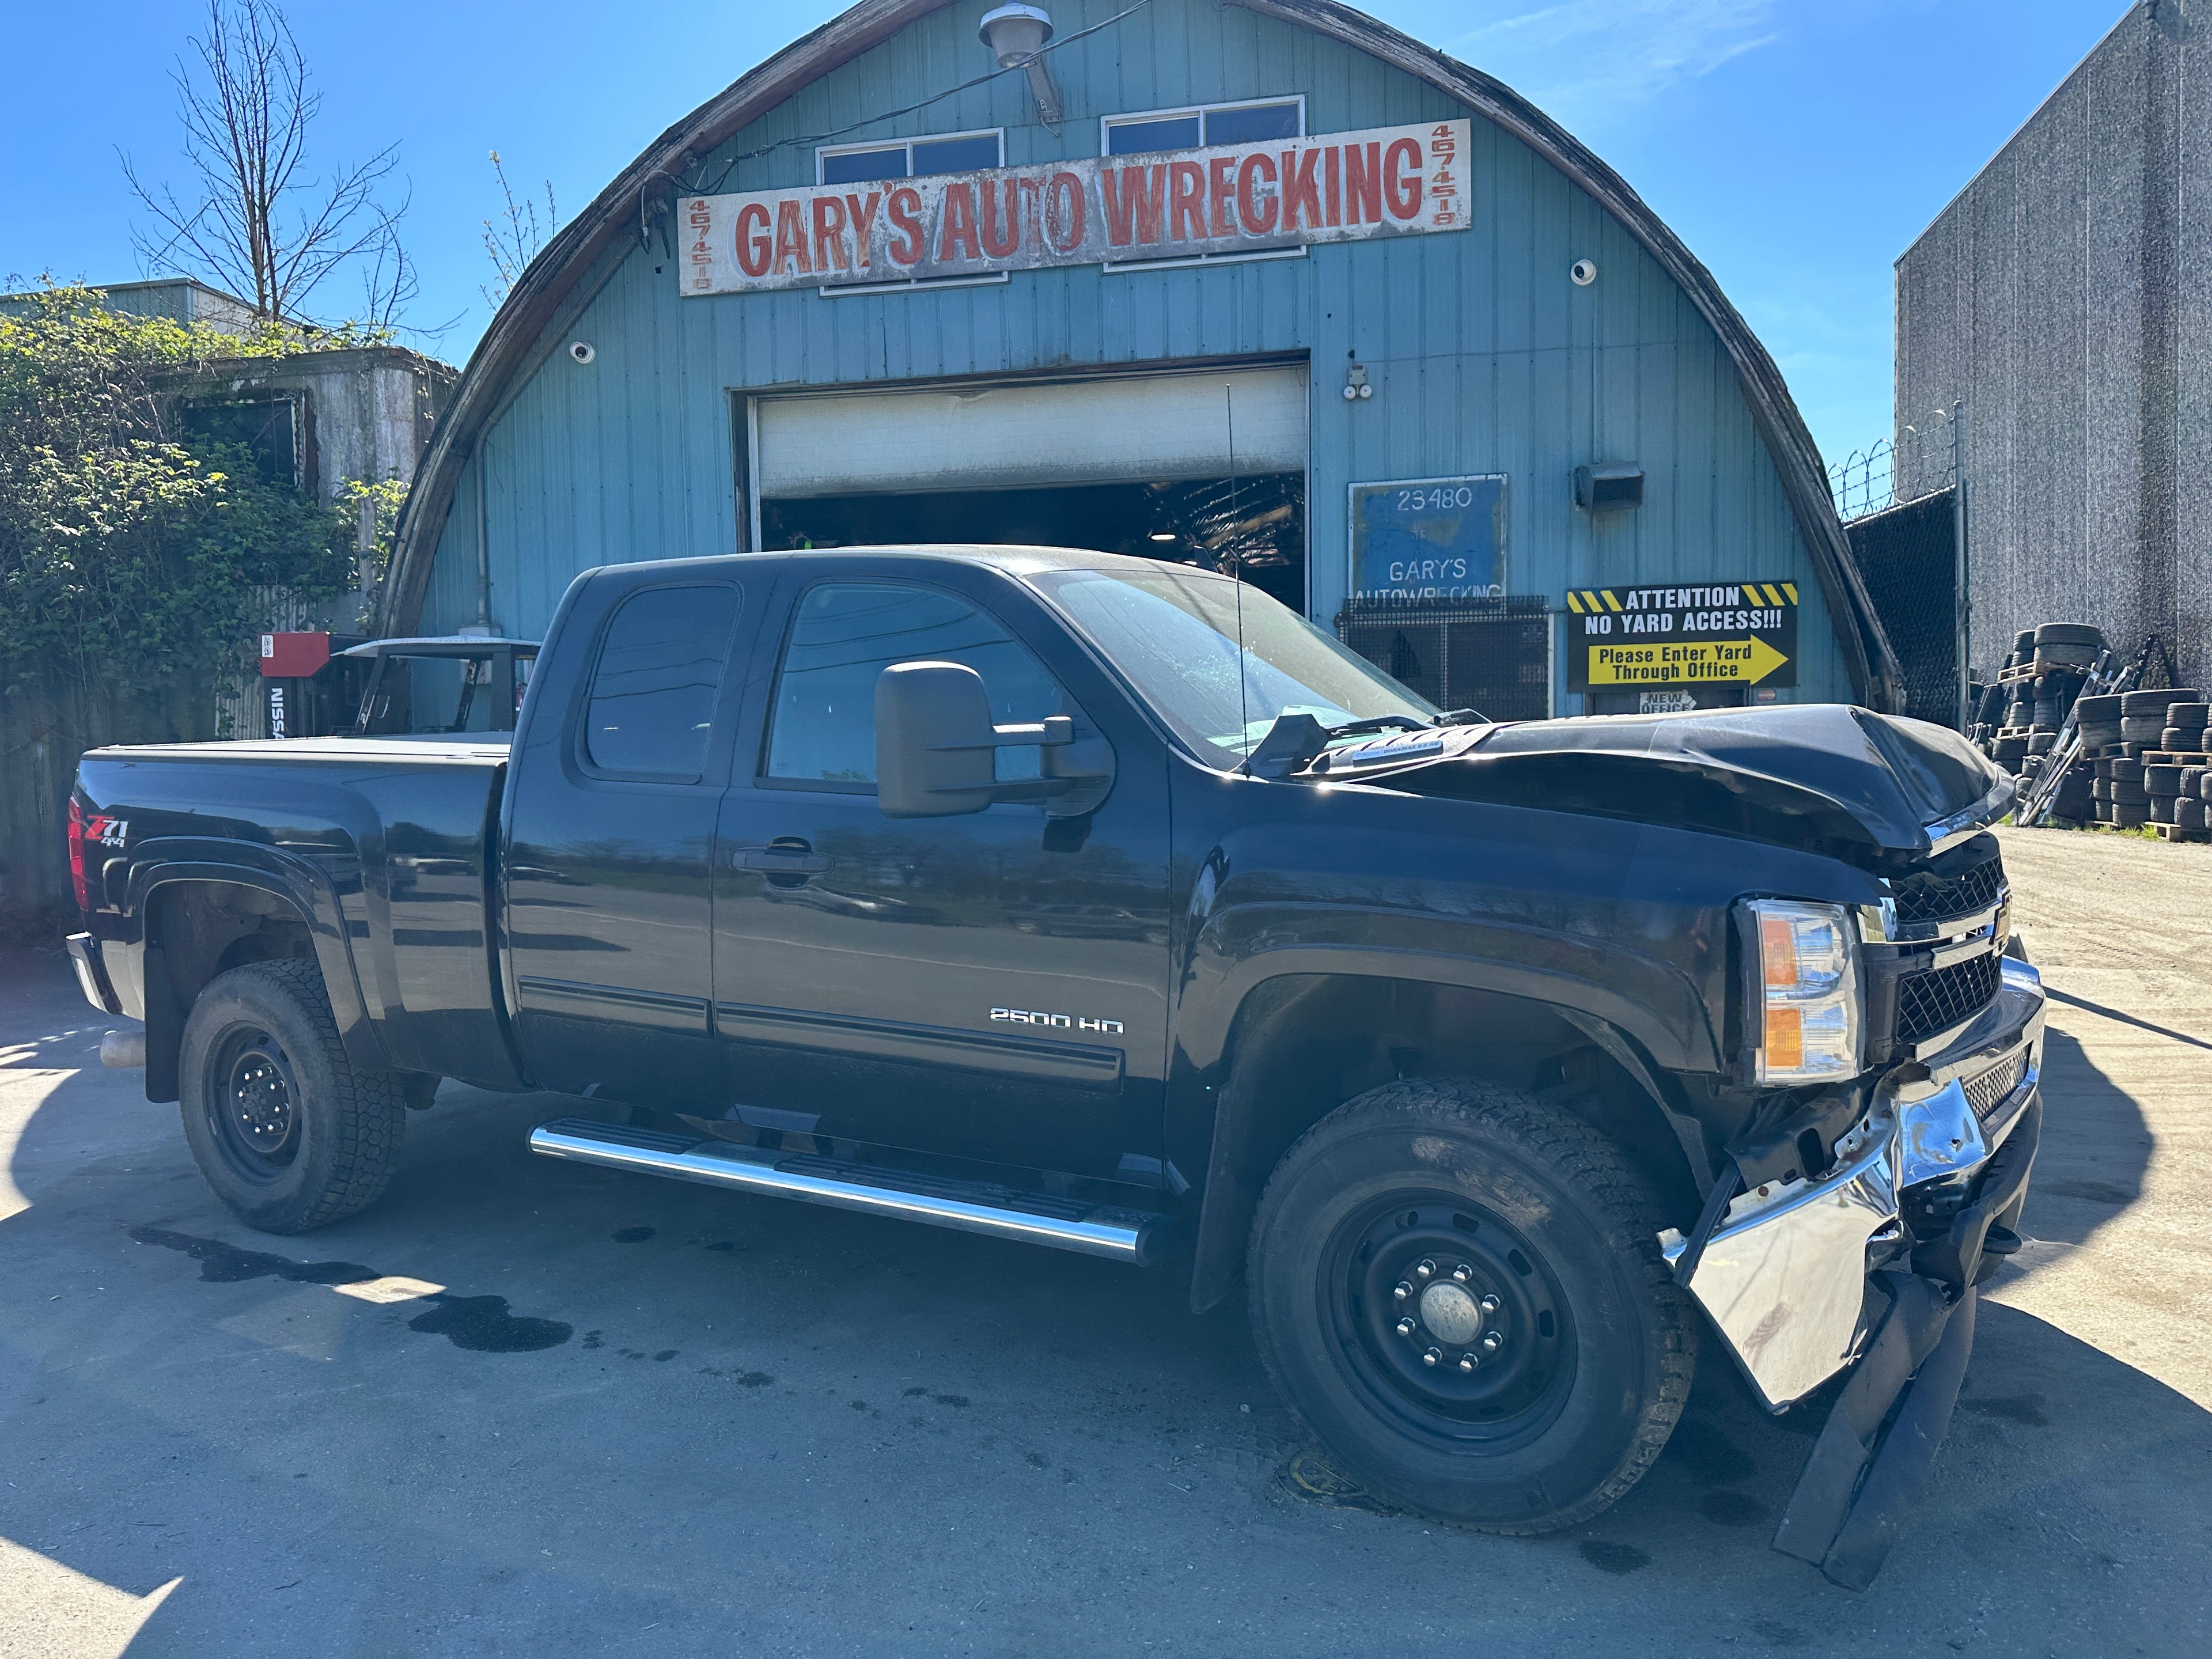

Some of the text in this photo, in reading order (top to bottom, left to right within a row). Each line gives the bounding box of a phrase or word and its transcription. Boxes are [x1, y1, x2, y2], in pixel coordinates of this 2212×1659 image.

[735, 137, 1423, 277] GARY'S AUTO WRECKING
[1397, 487, 1472, 511] 23480
[1389, 558, 1467, 582] GARY'S
[1625, 586, 1740, 611] ATTENTION
[1585, 609, 1782, 635] NO YARD ACCESS!!!
[1599, 643, 1752, 664] Please Enter Yard
[1612, 661, 1738, 682] Through Office
[1642, 703, 1690, 714] OFFICE
[1647, 692, 1683, 703] NEW
[85, 815, 128, 840] Z71
[990, 1007, 1124, 1036] 2500 HD
